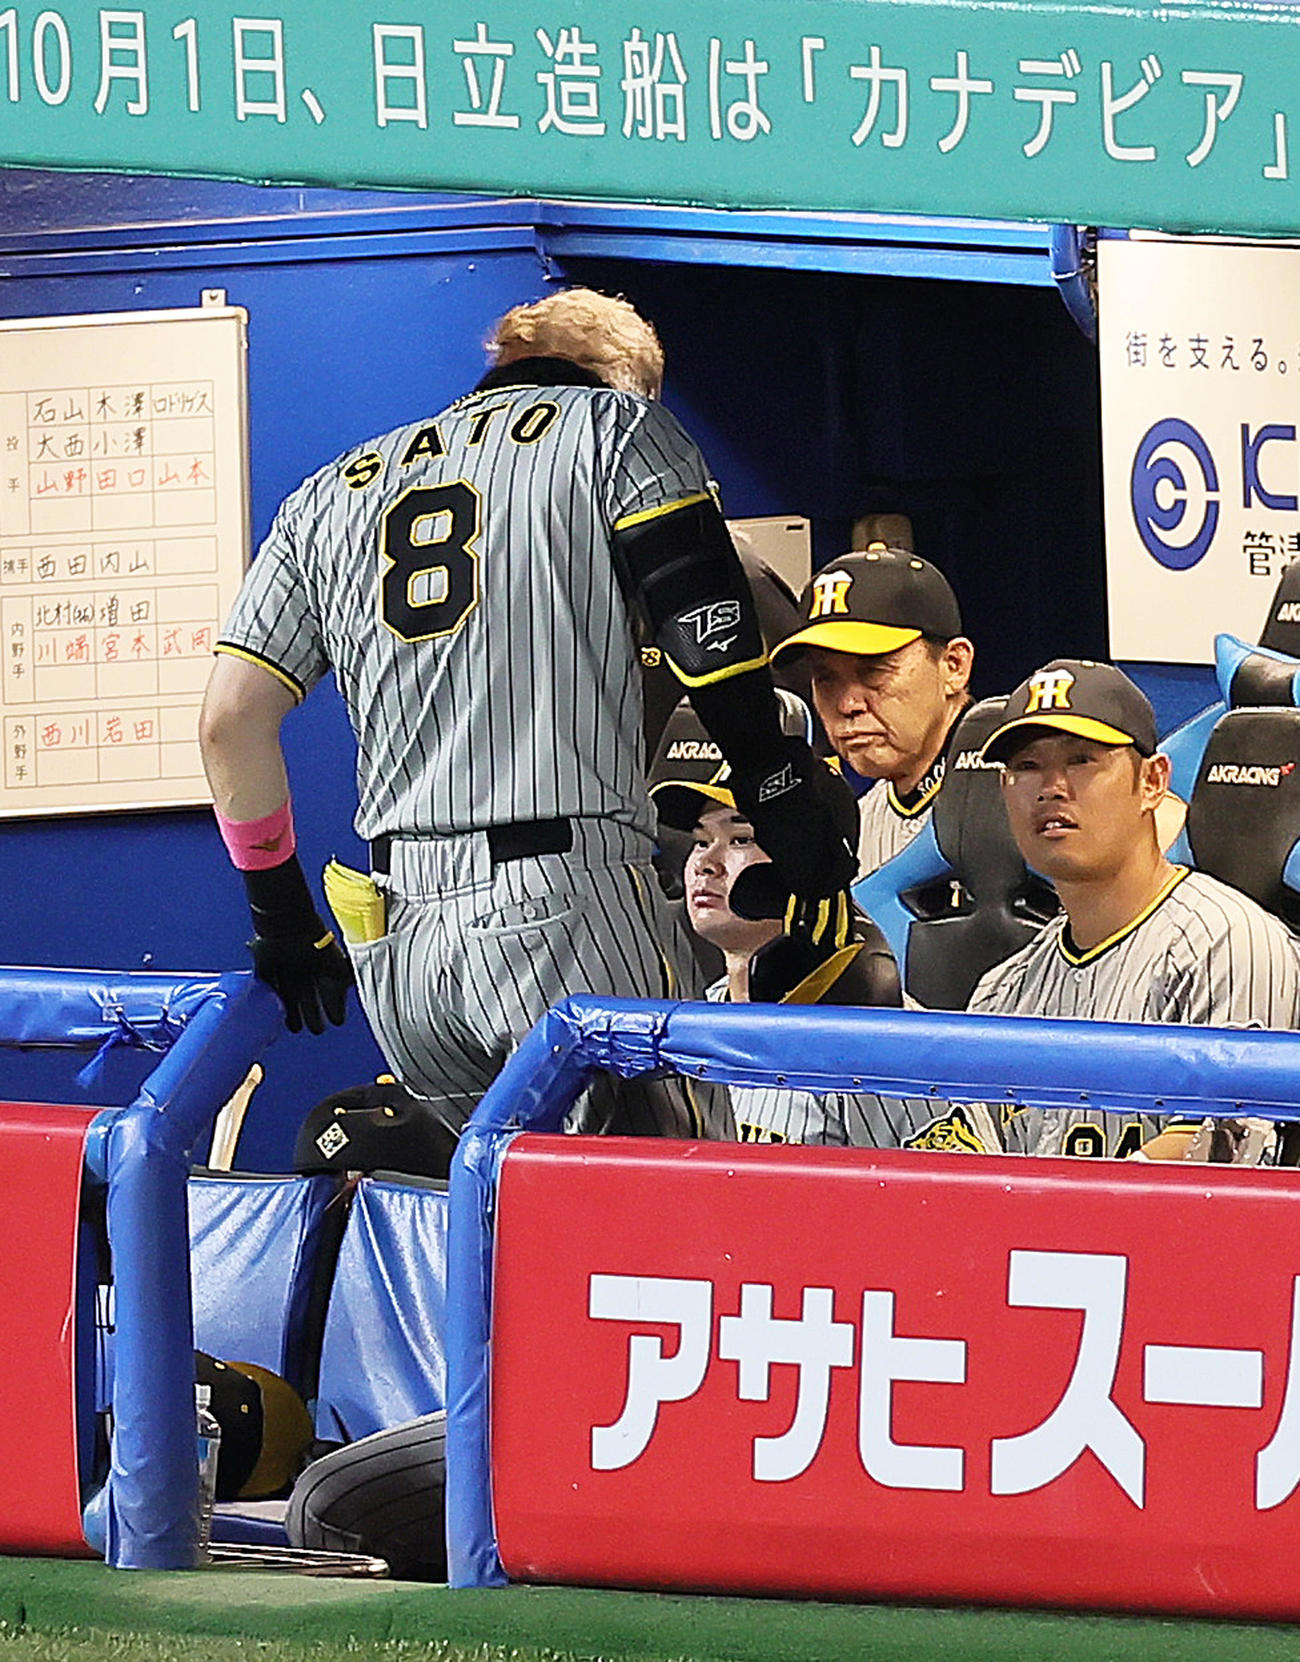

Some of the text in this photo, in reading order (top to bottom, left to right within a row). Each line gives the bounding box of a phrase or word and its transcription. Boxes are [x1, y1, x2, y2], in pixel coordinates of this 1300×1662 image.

[1126, 331, 1300, 374] 街を支える。
[33, 397, 84, 422] 石山
[36, 433, 84, 459] 大西
[341, 400, 561, 490] SATO
[36, 458, 209, 494] 山野 田口 山本
[37, 554, 87, 579] 西田
[380, 477, 482, 644] 8
[102, 629, 151, 660] 宮本
[41, 719, 89, 747] 西川
